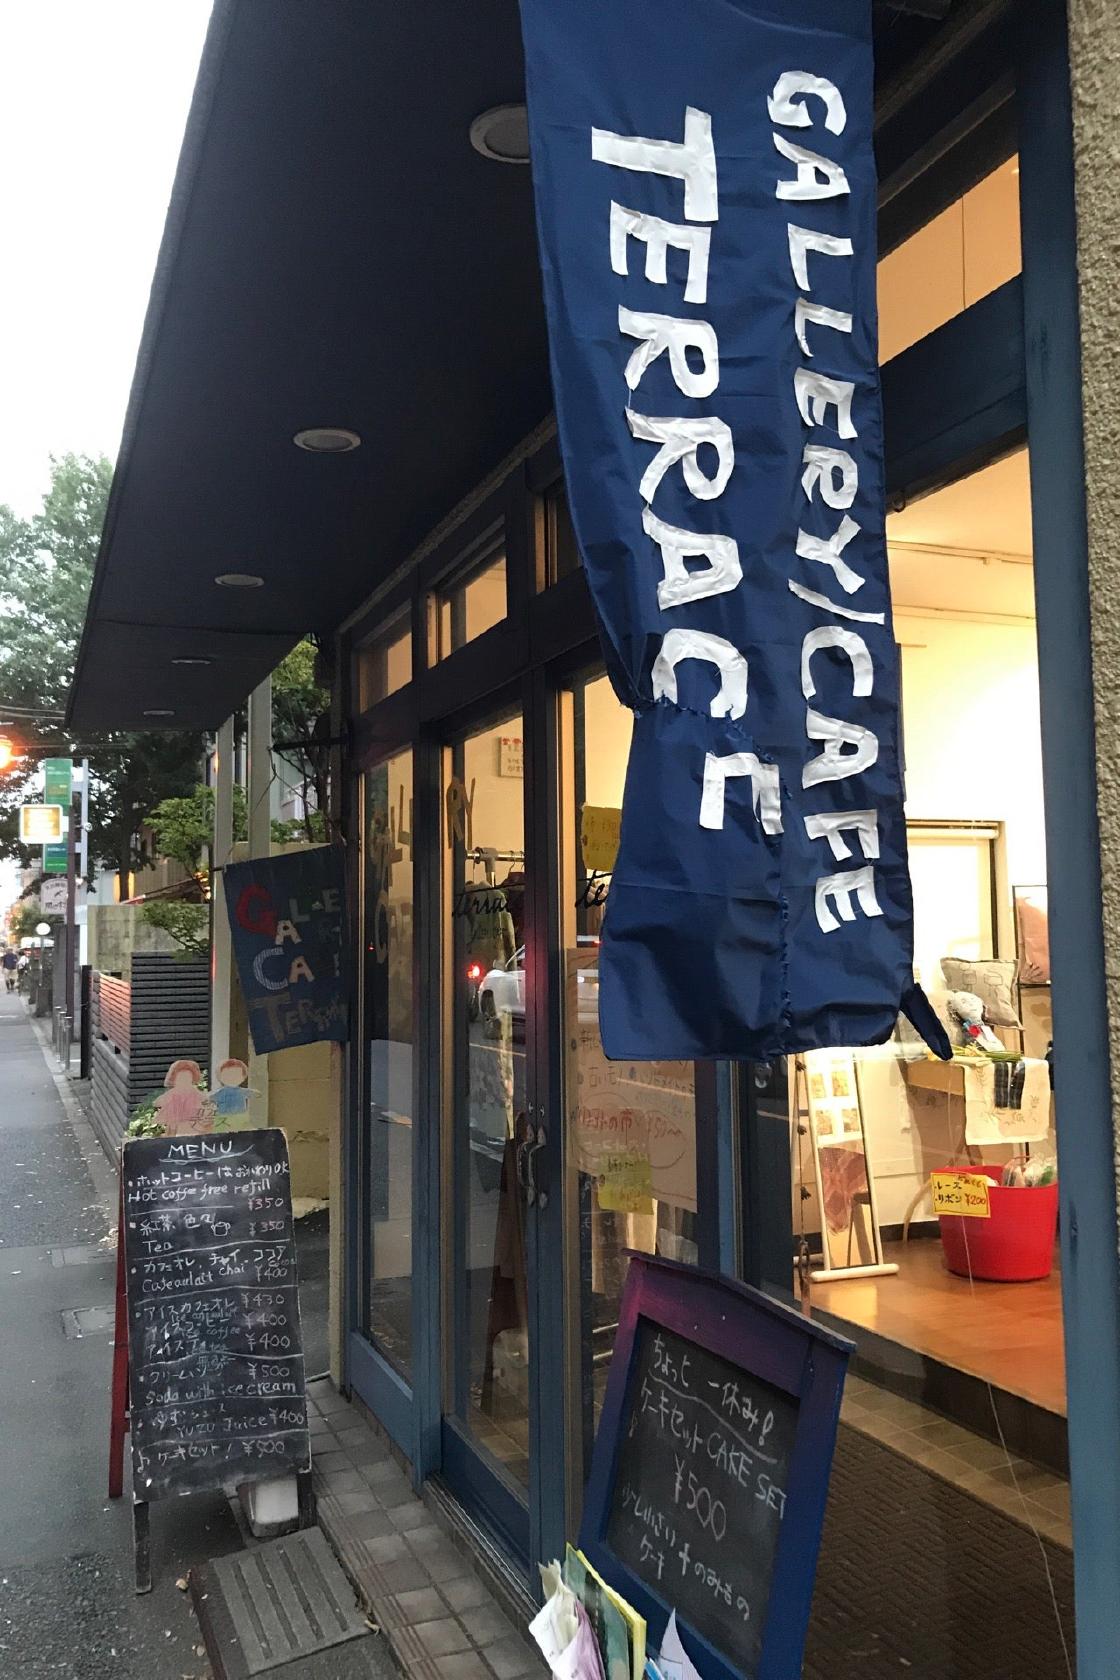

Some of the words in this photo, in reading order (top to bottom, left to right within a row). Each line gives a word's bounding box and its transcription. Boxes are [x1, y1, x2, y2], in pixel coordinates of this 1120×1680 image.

[591, 105, 784, 835] TERRACE
[168, 1141, 232, 1159] MENU
[128, 1189, 158, 1203] Hot
[162, 1186, 197, 1201] coffee
[200, 1183, 228, 1200] free
[234, 1178, 271, 1196] refill
[142, 1240, 173, 1253] Tea
[255, 1264, 288, 1282] ¥400
[245, 1332, 290, 1351] ¥400
[248, 1361, 290, 1379] ¥500
[145, 1385, 179, 1406] Soda
[185, 1381, 215, 1400] with
[223, 1415, 268, 1432] Juice
[268, 1407, 305, 1425] ¥400
[707, 1432, 753, 1488] CAKE
[755, 1473, 787, 1520] SET
[674, 1453, 727, 1541] ¥500
